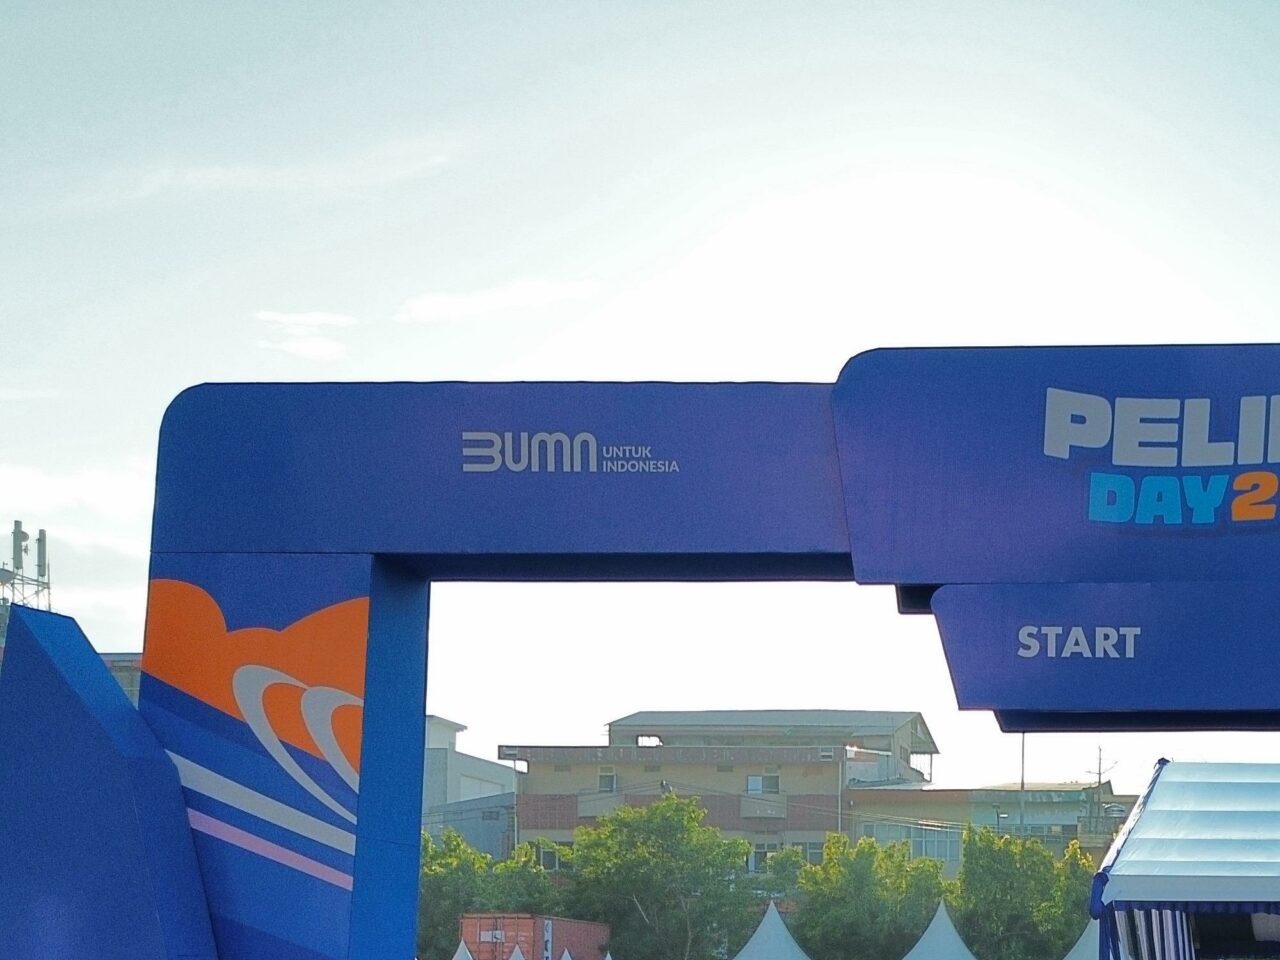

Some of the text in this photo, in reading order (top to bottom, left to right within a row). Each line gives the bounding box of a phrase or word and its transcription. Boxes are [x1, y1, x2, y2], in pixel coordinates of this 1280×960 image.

[602, 446, 652, 458] UNTUK
[602, 460, 680, 473] INDONESIA
[1017, 625, 1141, 659] START
